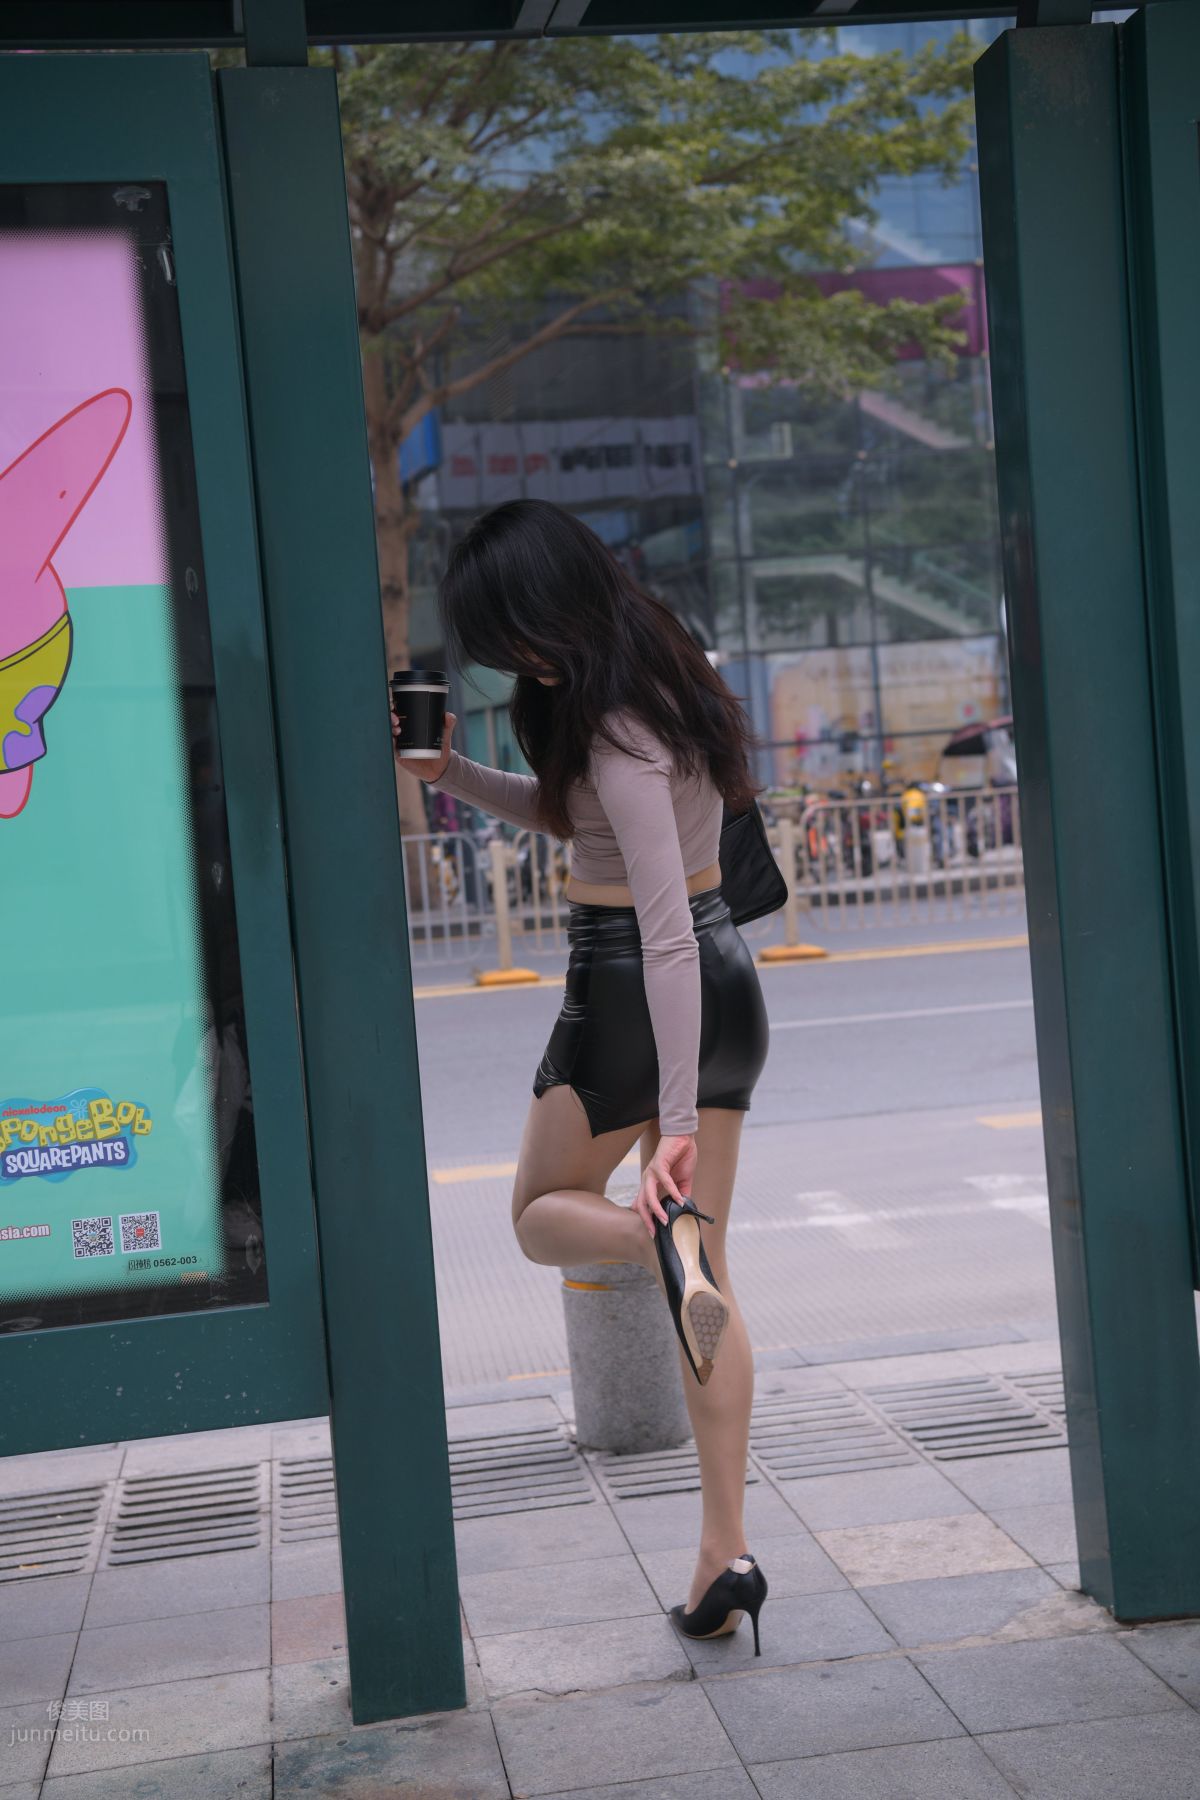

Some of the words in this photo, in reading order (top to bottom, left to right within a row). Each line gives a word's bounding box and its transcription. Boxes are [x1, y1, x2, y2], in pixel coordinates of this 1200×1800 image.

[5, 1142, 126, 1174] SQUAREPANTS
[0, 1225, 50, 1240] sia.com
[153, 1256, 198, 1268] 0562-003
